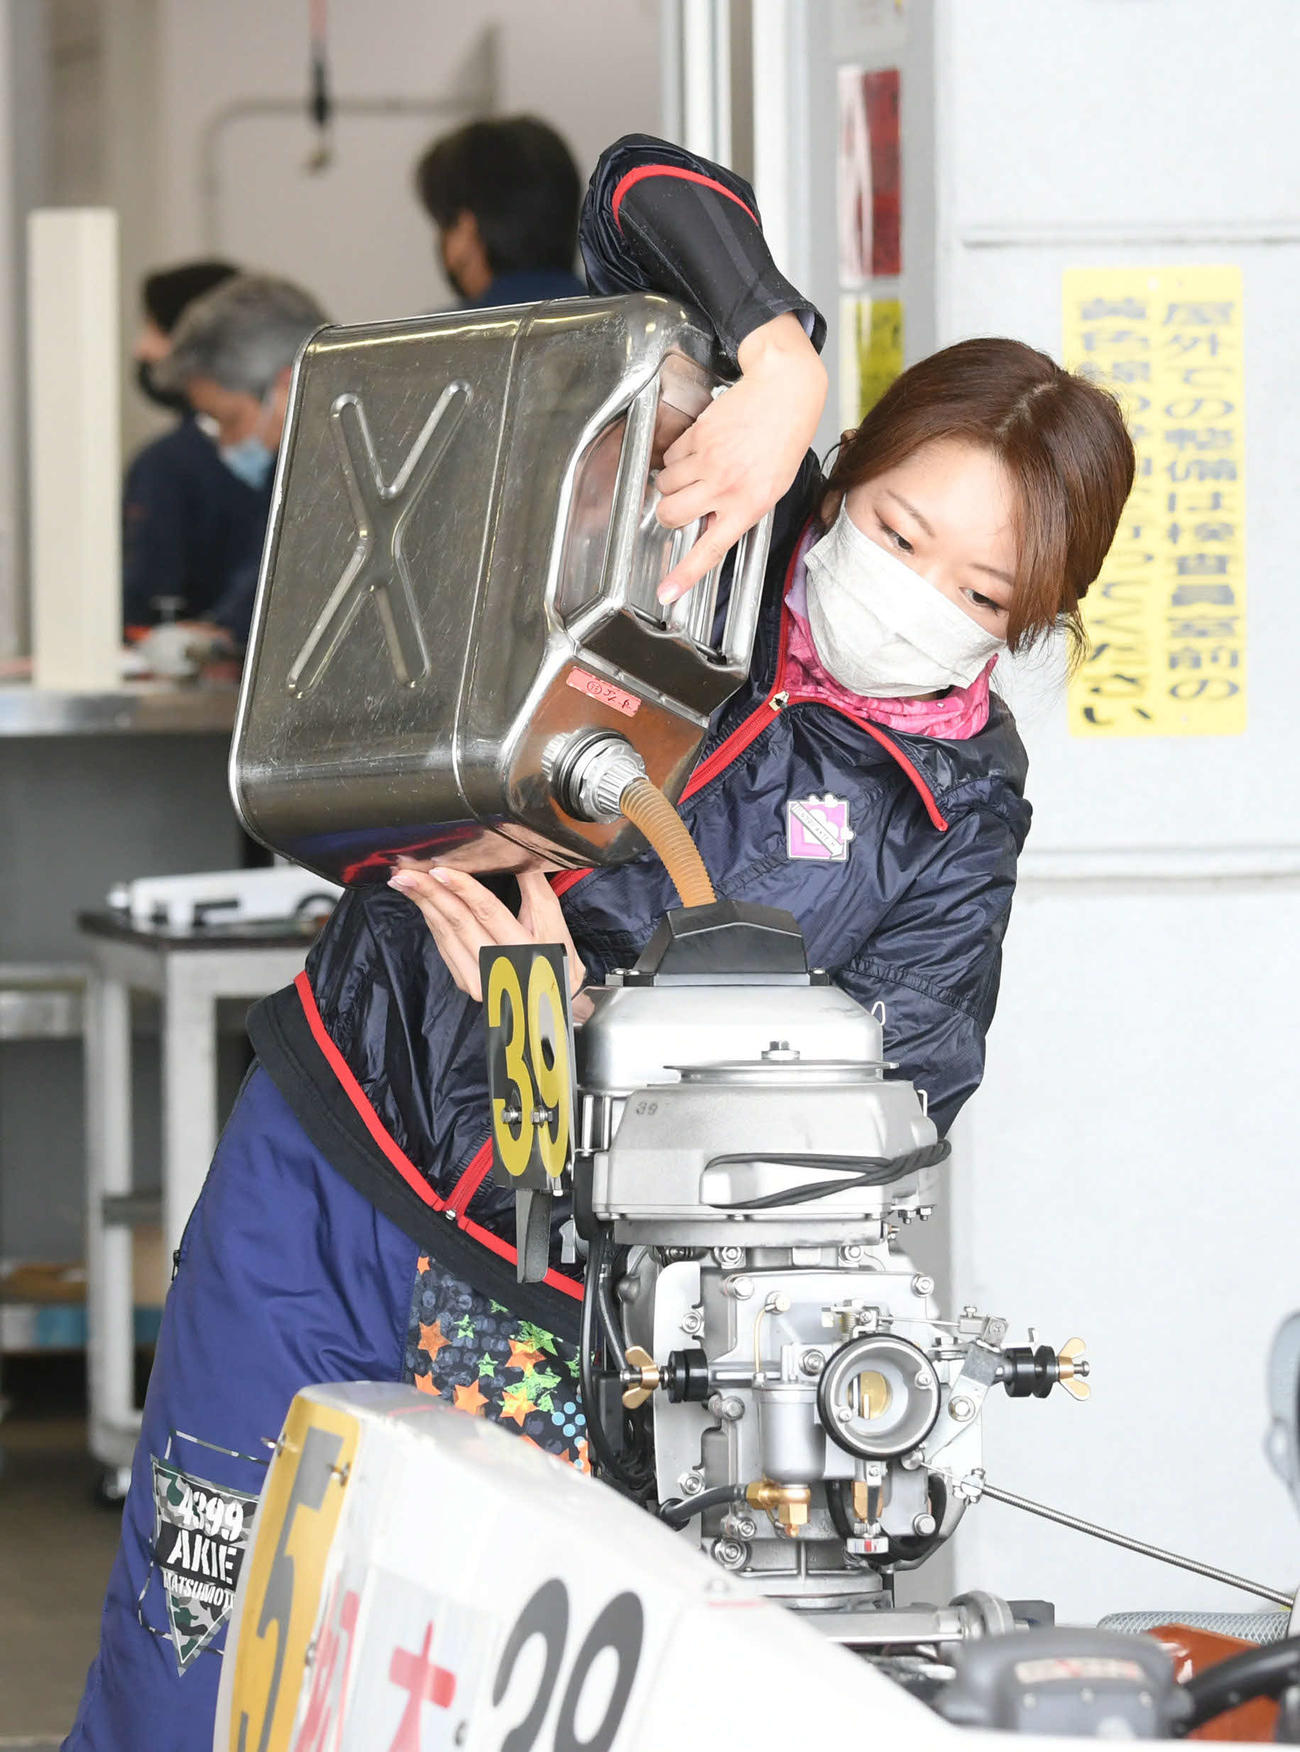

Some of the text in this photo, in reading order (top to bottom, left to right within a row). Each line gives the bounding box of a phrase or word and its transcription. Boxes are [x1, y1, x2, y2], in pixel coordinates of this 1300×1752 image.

[488, 956, 570, 1178] 39
[635, 1101, 659, 1116] 39
[177, 1486, 244, 1542] 4399
[166, 1528, 238, 1585] AKIE
